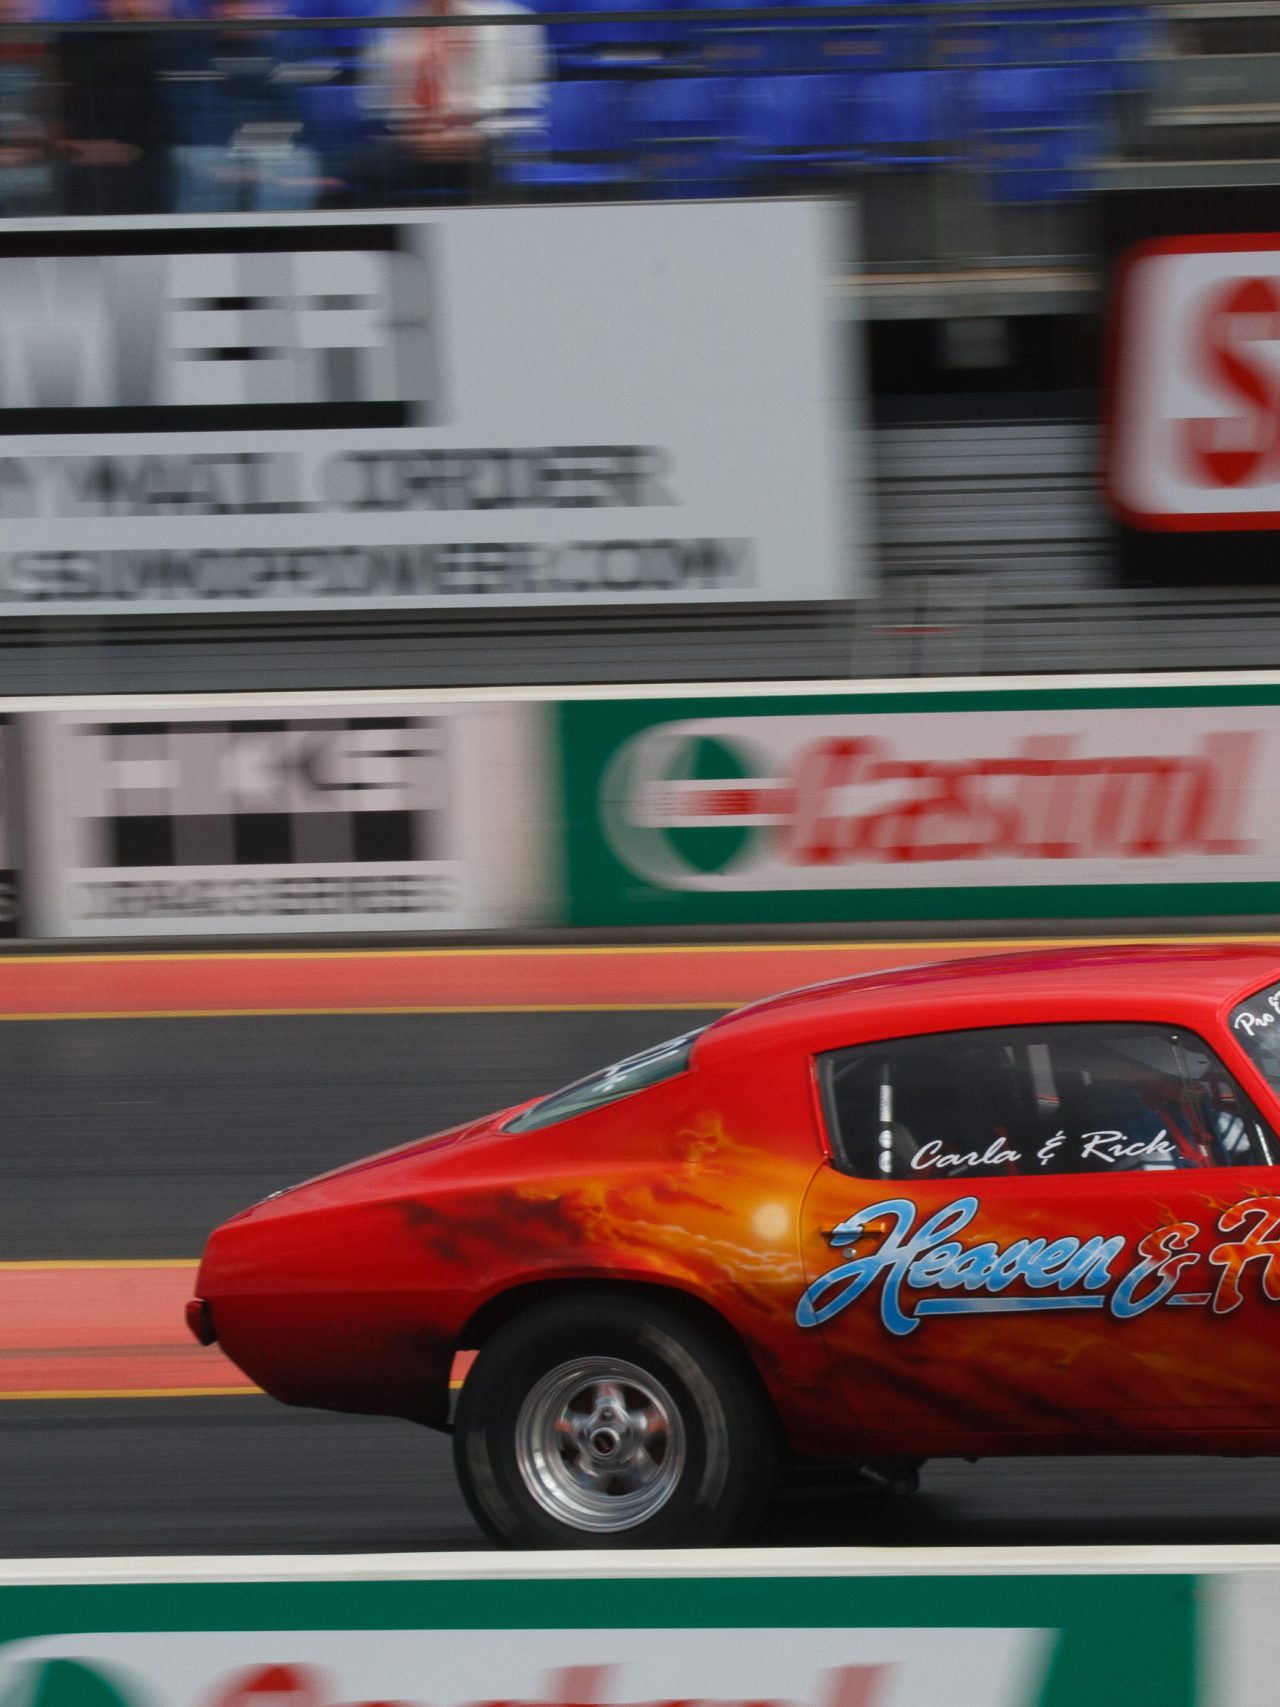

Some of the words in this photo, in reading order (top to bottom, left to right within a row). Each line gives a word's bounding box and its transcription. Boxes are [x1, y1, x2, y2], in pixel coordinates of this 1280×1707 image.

[64, 451, 316, 517] MAIL
[328, 445, 676, 511] ORDER
[785, 730, 1262, 866] Castrol
[1234, 1012, 1275, 1036] Pro
[910, 1139, 1022, 1171] Carla
[1037, 1130, 1067, 1166] &
[1081, 1130, 1175, 1162] Rick
[795, 1196, 1124, 1336] Heaven
[1111, 1222, 1201, 1318] &
